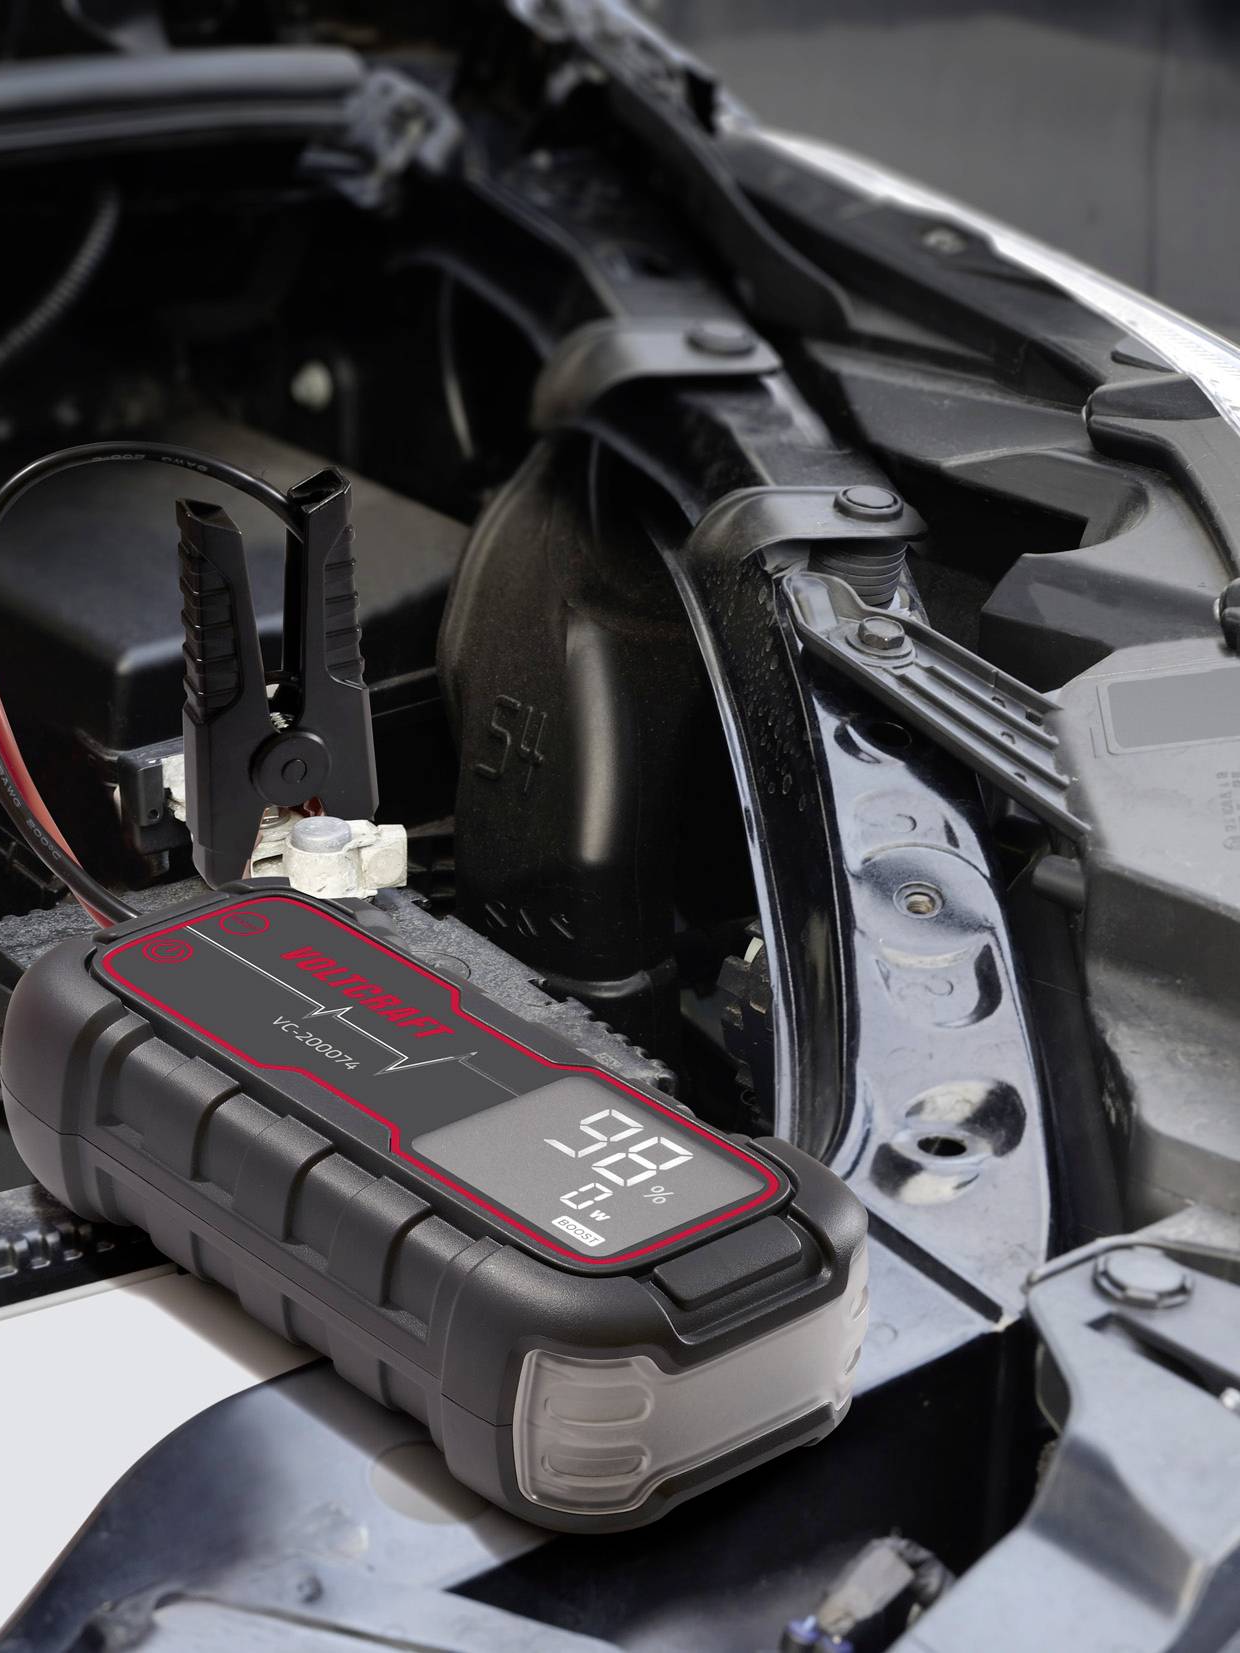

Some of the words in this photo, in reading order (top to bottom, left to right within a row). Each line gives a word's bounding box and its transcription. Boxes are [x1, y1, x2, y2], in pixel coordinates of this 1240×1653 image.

[280, 946, 456, 1039] VOLTCRAFT
[272, 1015, 360, 1071] VC-200074
[543, 1109, 694, 1187] 98
[557, 1218, 600, 1245] BOOST
